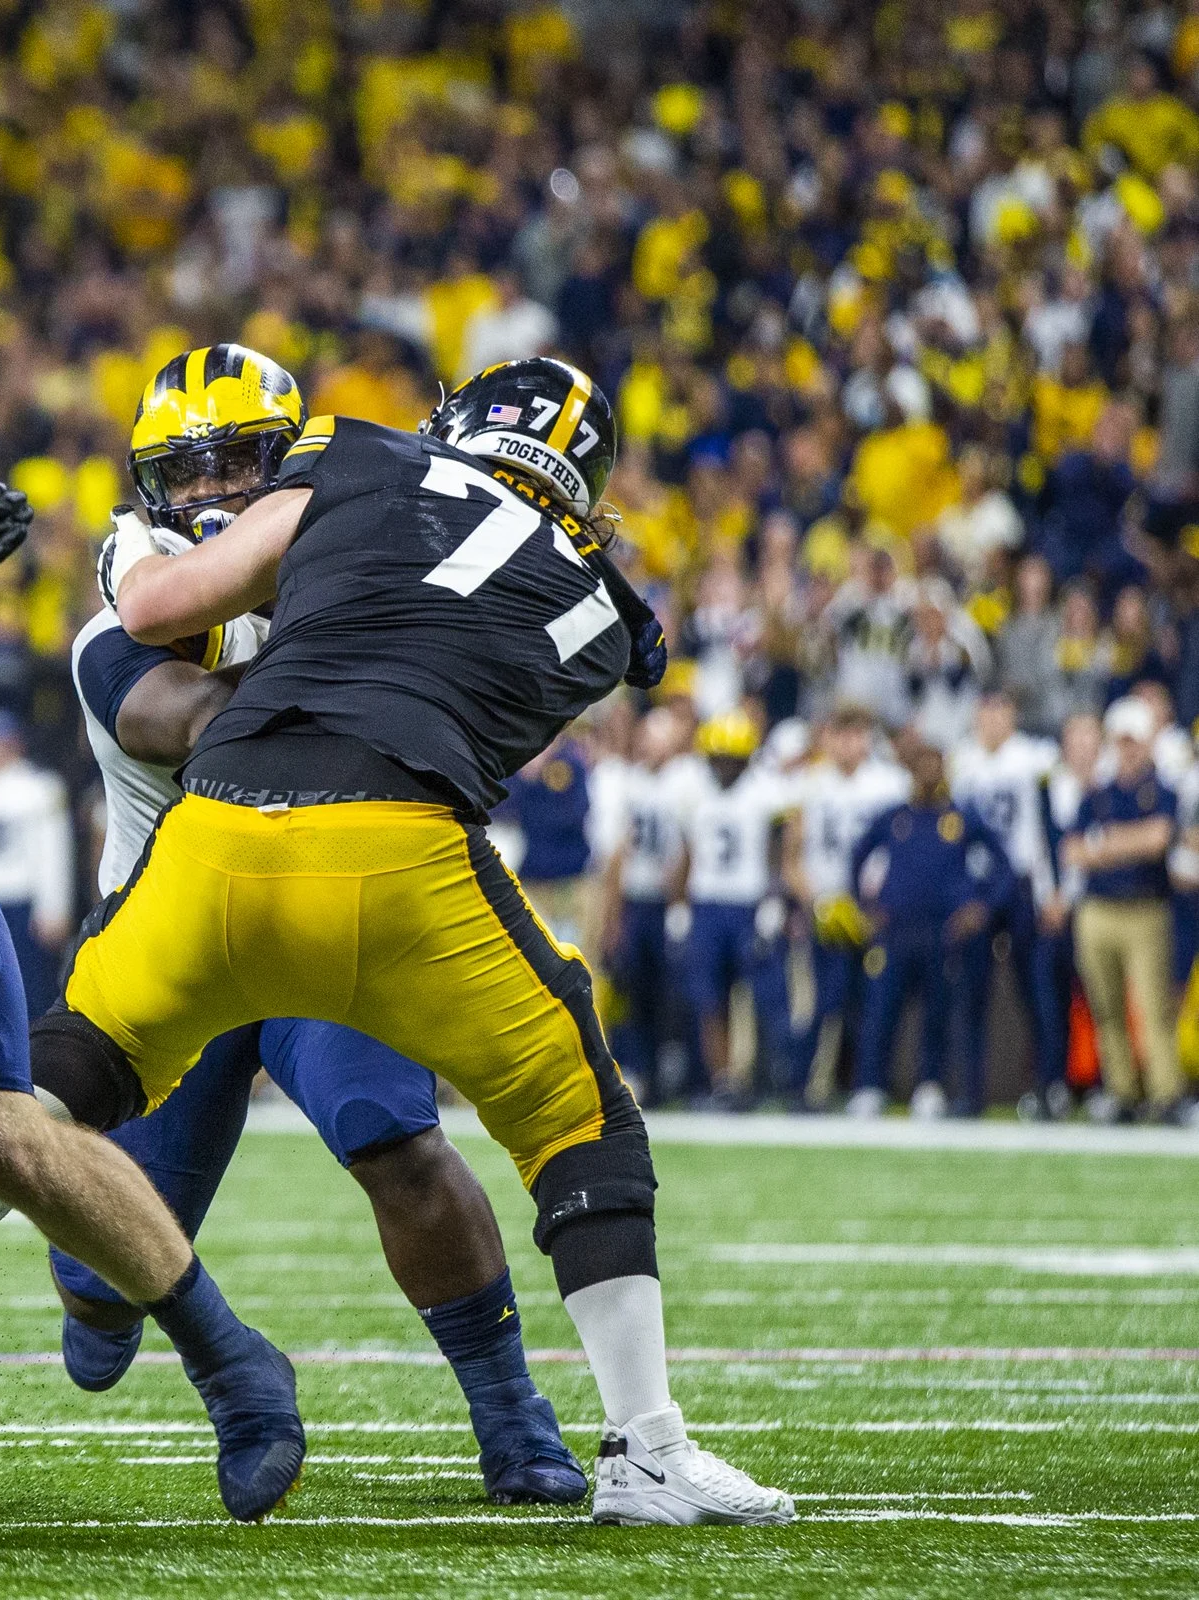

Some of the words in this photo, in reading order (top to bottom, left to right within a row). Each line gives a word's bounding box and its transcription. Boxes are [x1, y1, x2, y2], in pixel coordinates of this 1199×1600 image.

[528, 396, 599, 458] 77
[493, 437, 580, 500] TOGETHER
[419, 455, 619, 664] 77
